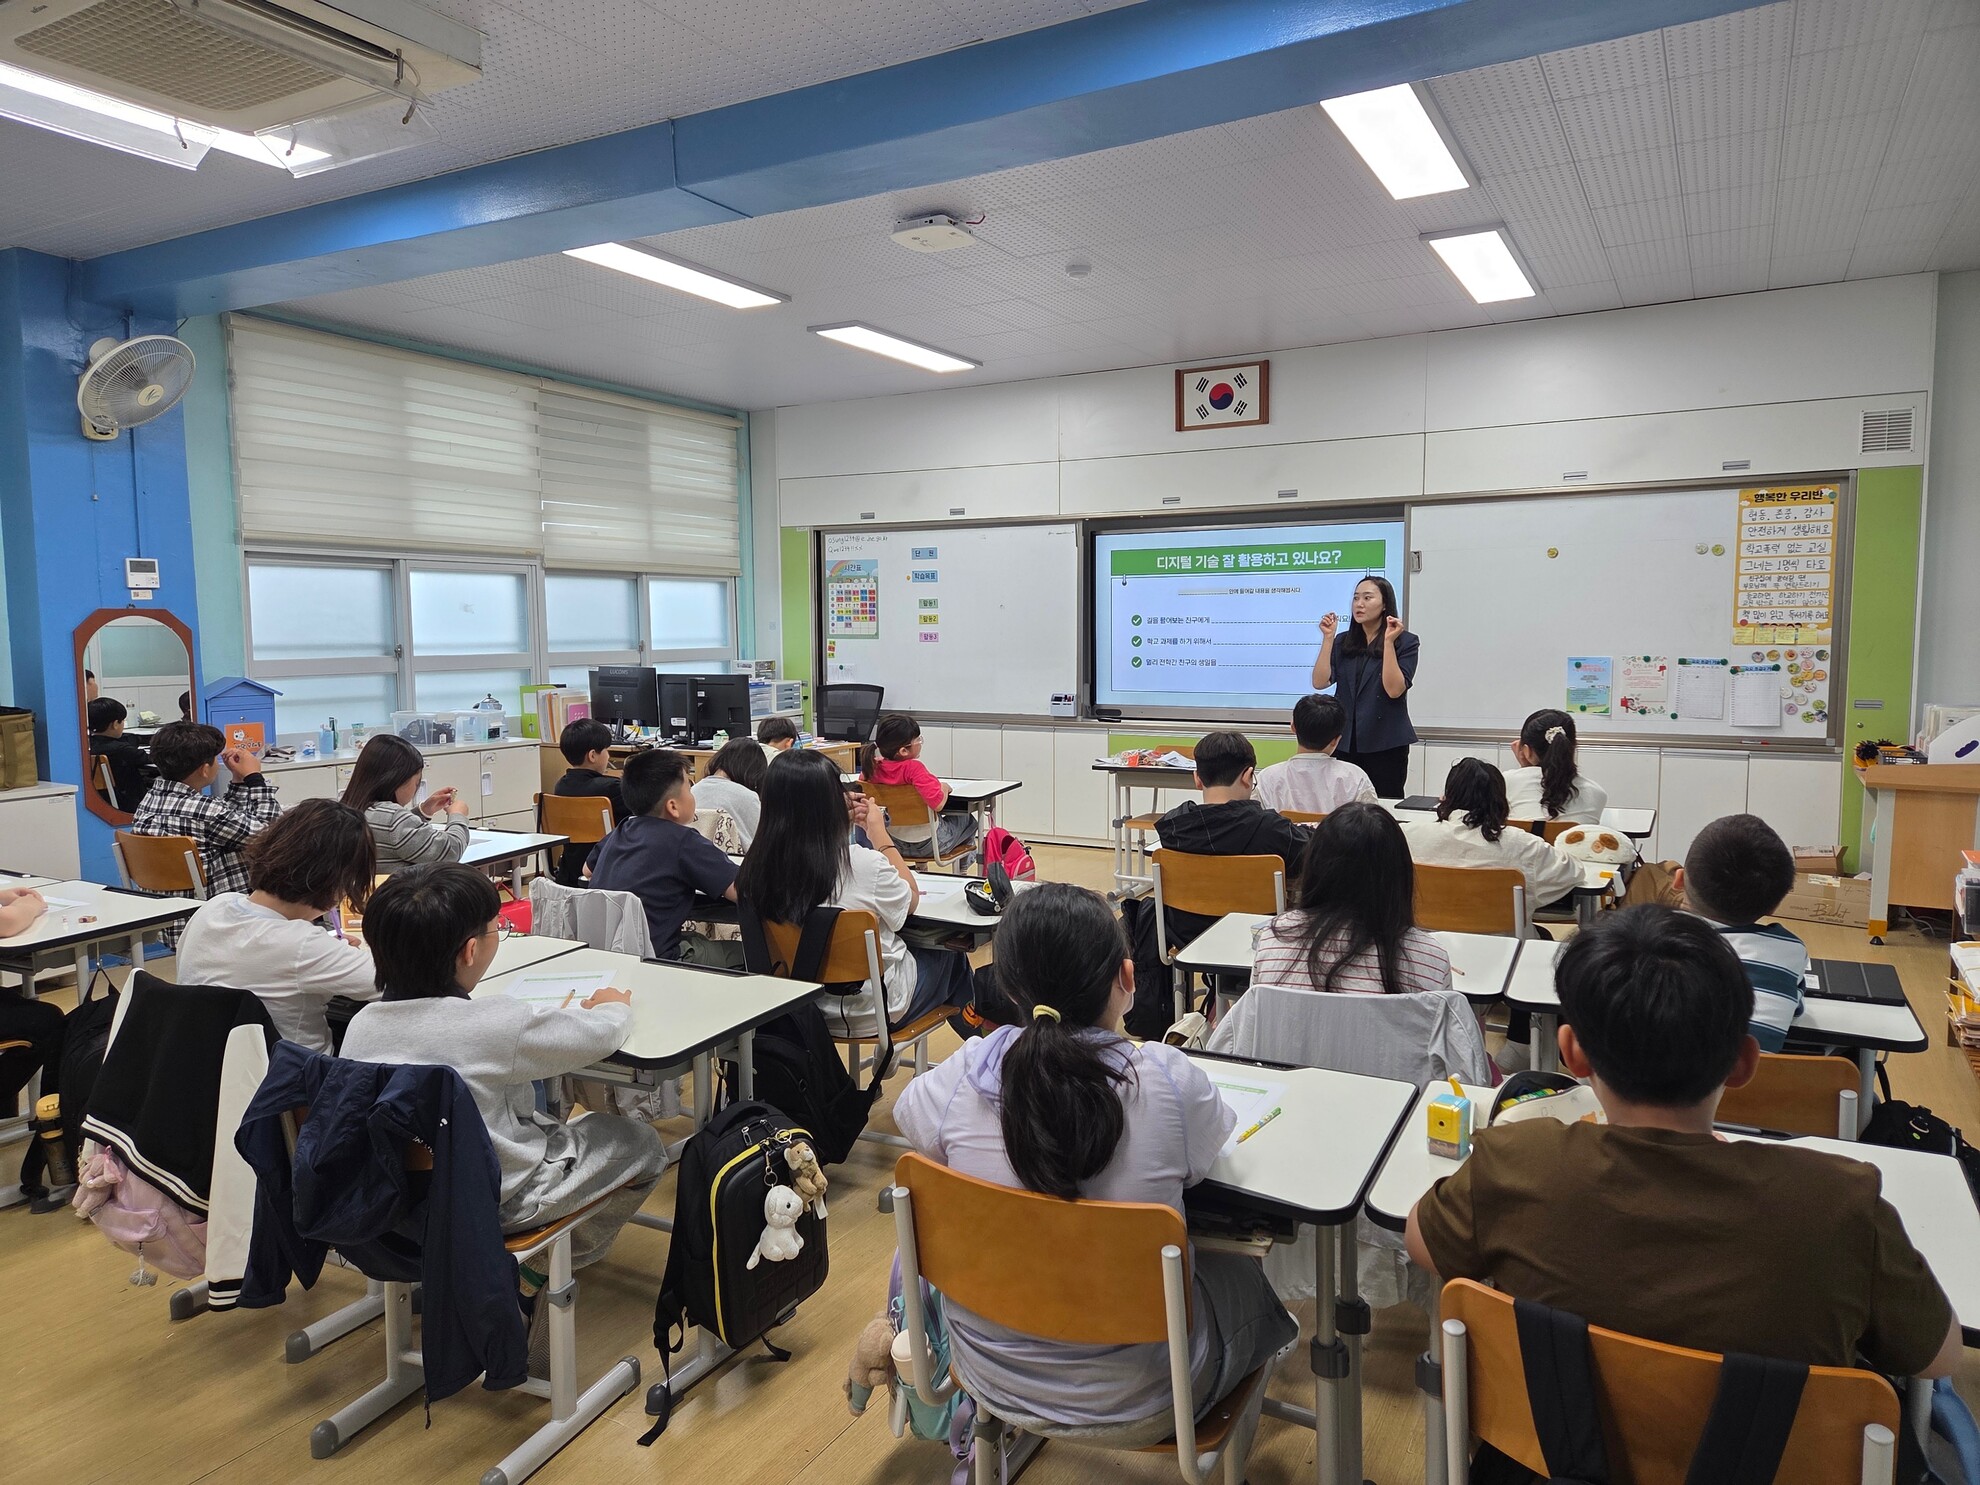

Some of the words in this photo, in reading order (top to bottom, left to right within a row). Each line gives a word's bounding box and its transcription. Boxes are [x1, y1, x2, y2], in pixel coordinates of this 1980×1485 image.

[1754, 492, 1787, 503] 행복한
[1790, 490, 1824, 501] 우리반
[1803, 507, 1825, 519] 감사
[1747, 525, 1787, 537] 안전하게
[1746, 543, 1780, 555] 학교폭력
[1787, 542, 1802, 554] 없는
[1806, 542, 1827, 554] 교실
[1156, 555, 1192, 569] 디지털
[1195, 554, 1220, 569] 기술
[1222, 553, 1234, 568] 잘
[1237, 552, 1289, 567] 활용하고
[1292, 550, 1342, 566] 있나요?
[1744, 560, 1773, 571] 그네는
[914, 572, 936, 580] 학습목표
[1753, 610, 1767, 620] 많이
[1198, 659, 1217, 667] 생일을
